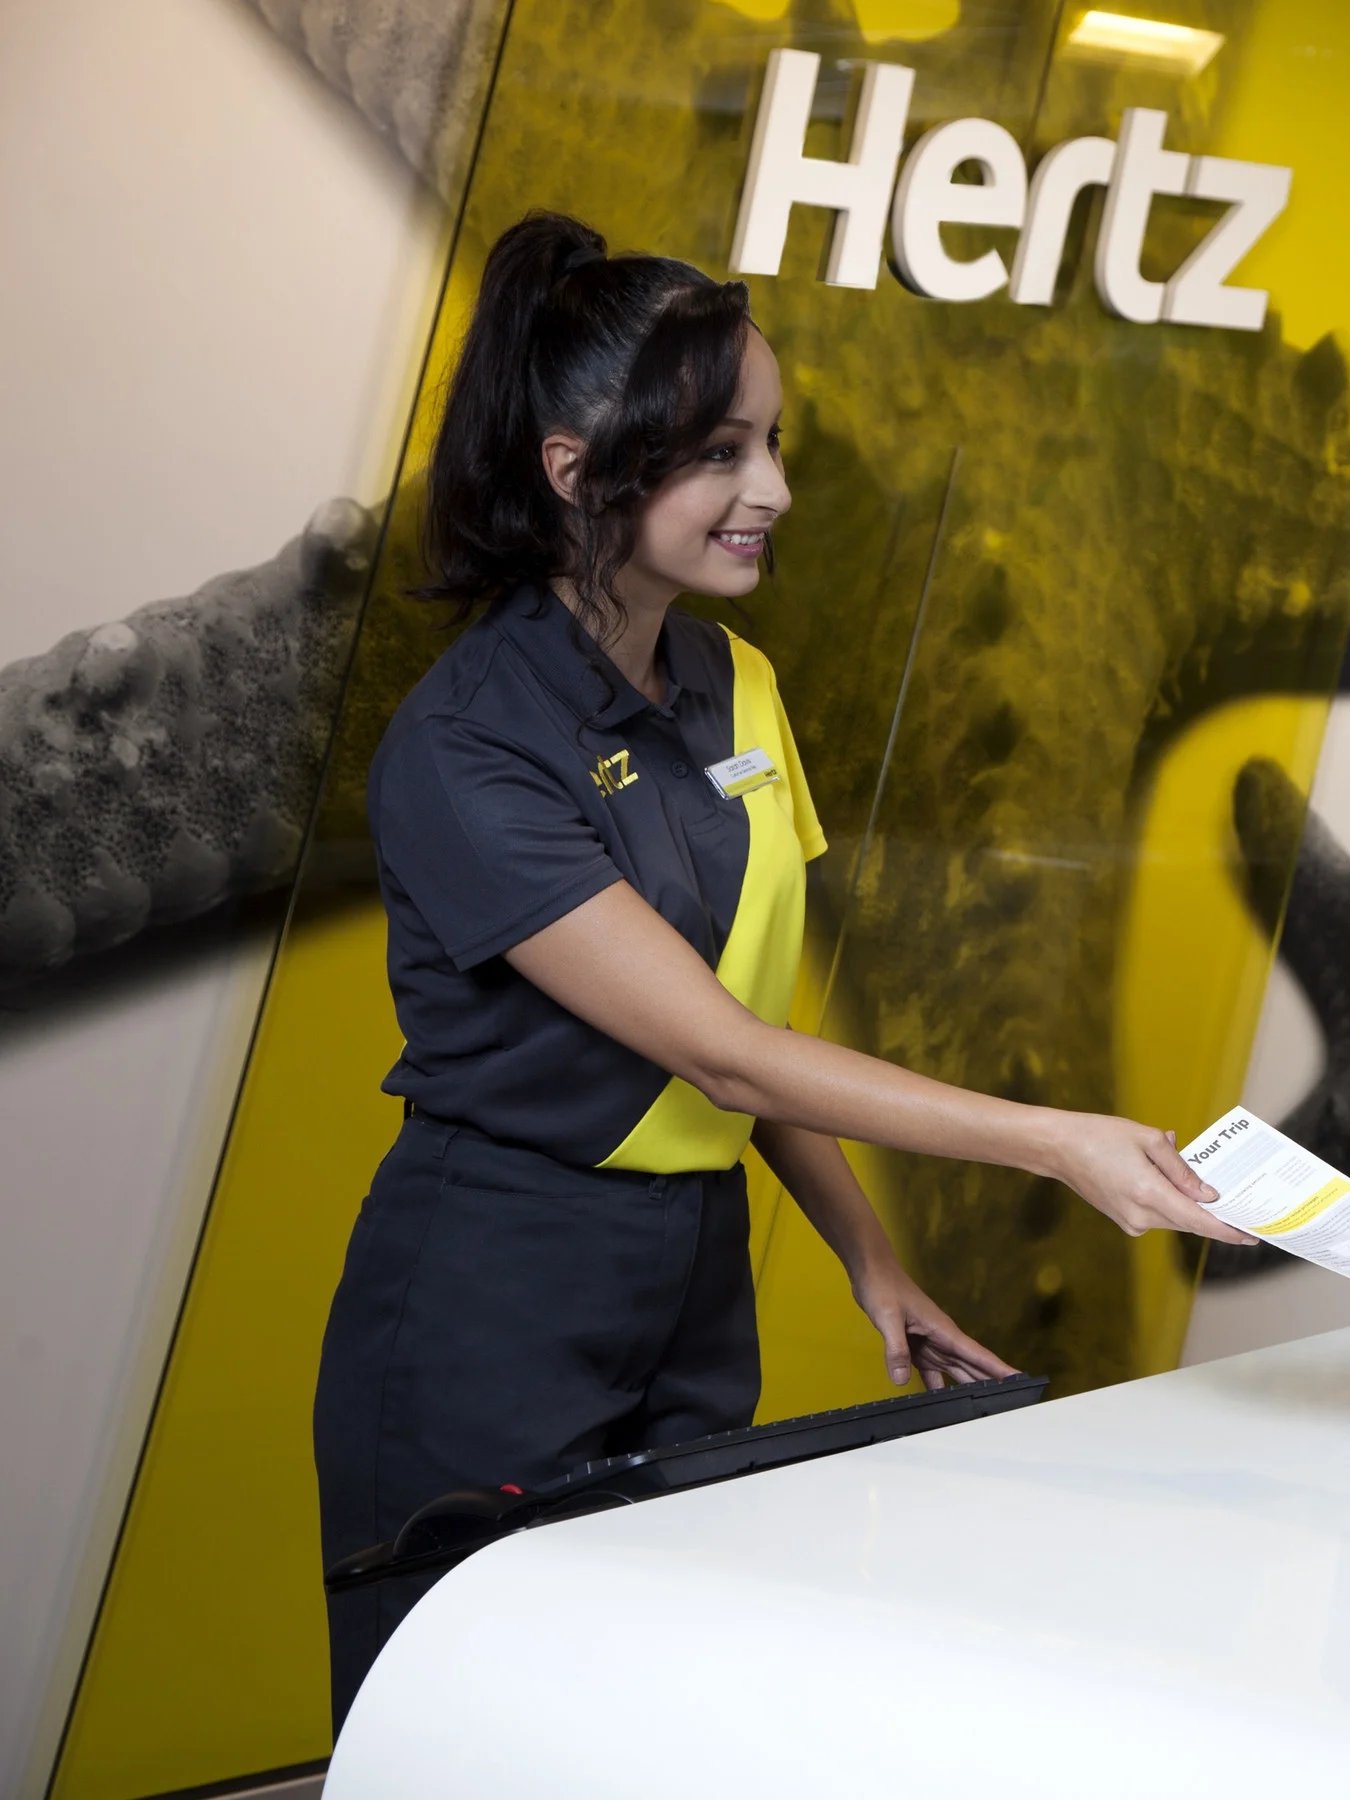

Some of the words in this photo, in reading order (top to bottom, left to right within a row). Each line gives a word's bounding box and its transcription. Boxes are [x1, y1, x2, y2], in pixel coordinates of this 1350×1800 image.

[728, 48, 1293, 331] Hertz
[590, 749, 639, 798] rtz
[1187, 1140, 1222, 1164] Your
[1218, 1119, 1250, 1139] Trip
